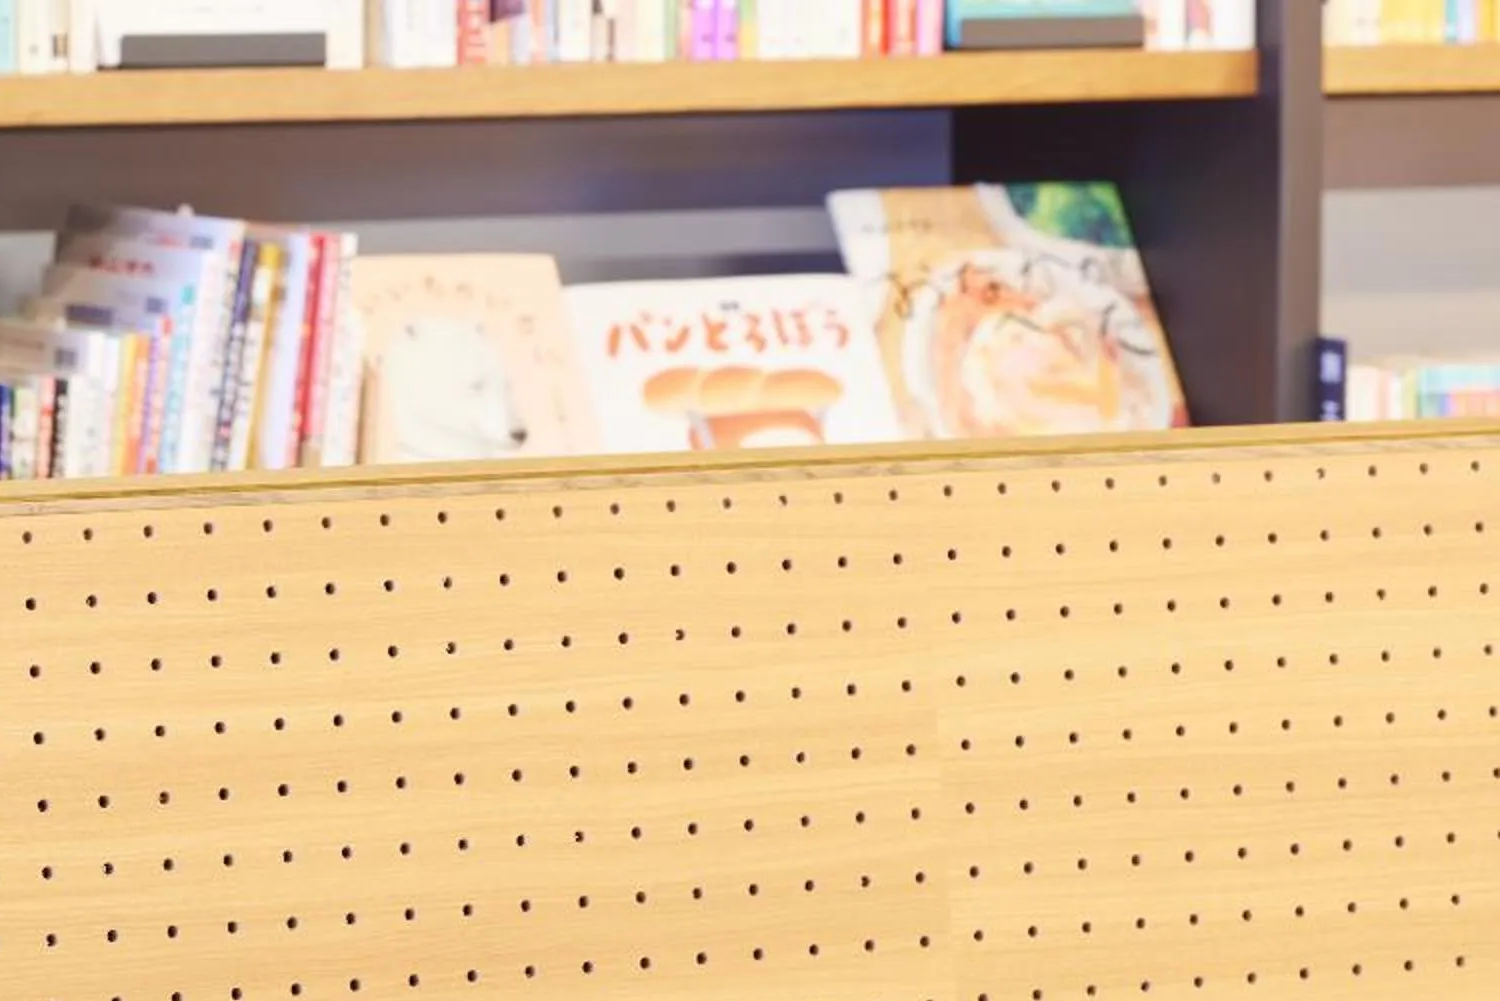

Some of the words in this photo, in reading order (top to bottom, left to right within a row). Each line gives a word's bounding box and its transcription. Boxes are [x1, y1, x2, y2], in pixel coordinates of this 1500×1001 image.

[606, 308, 851, 360] パンどろぼう
